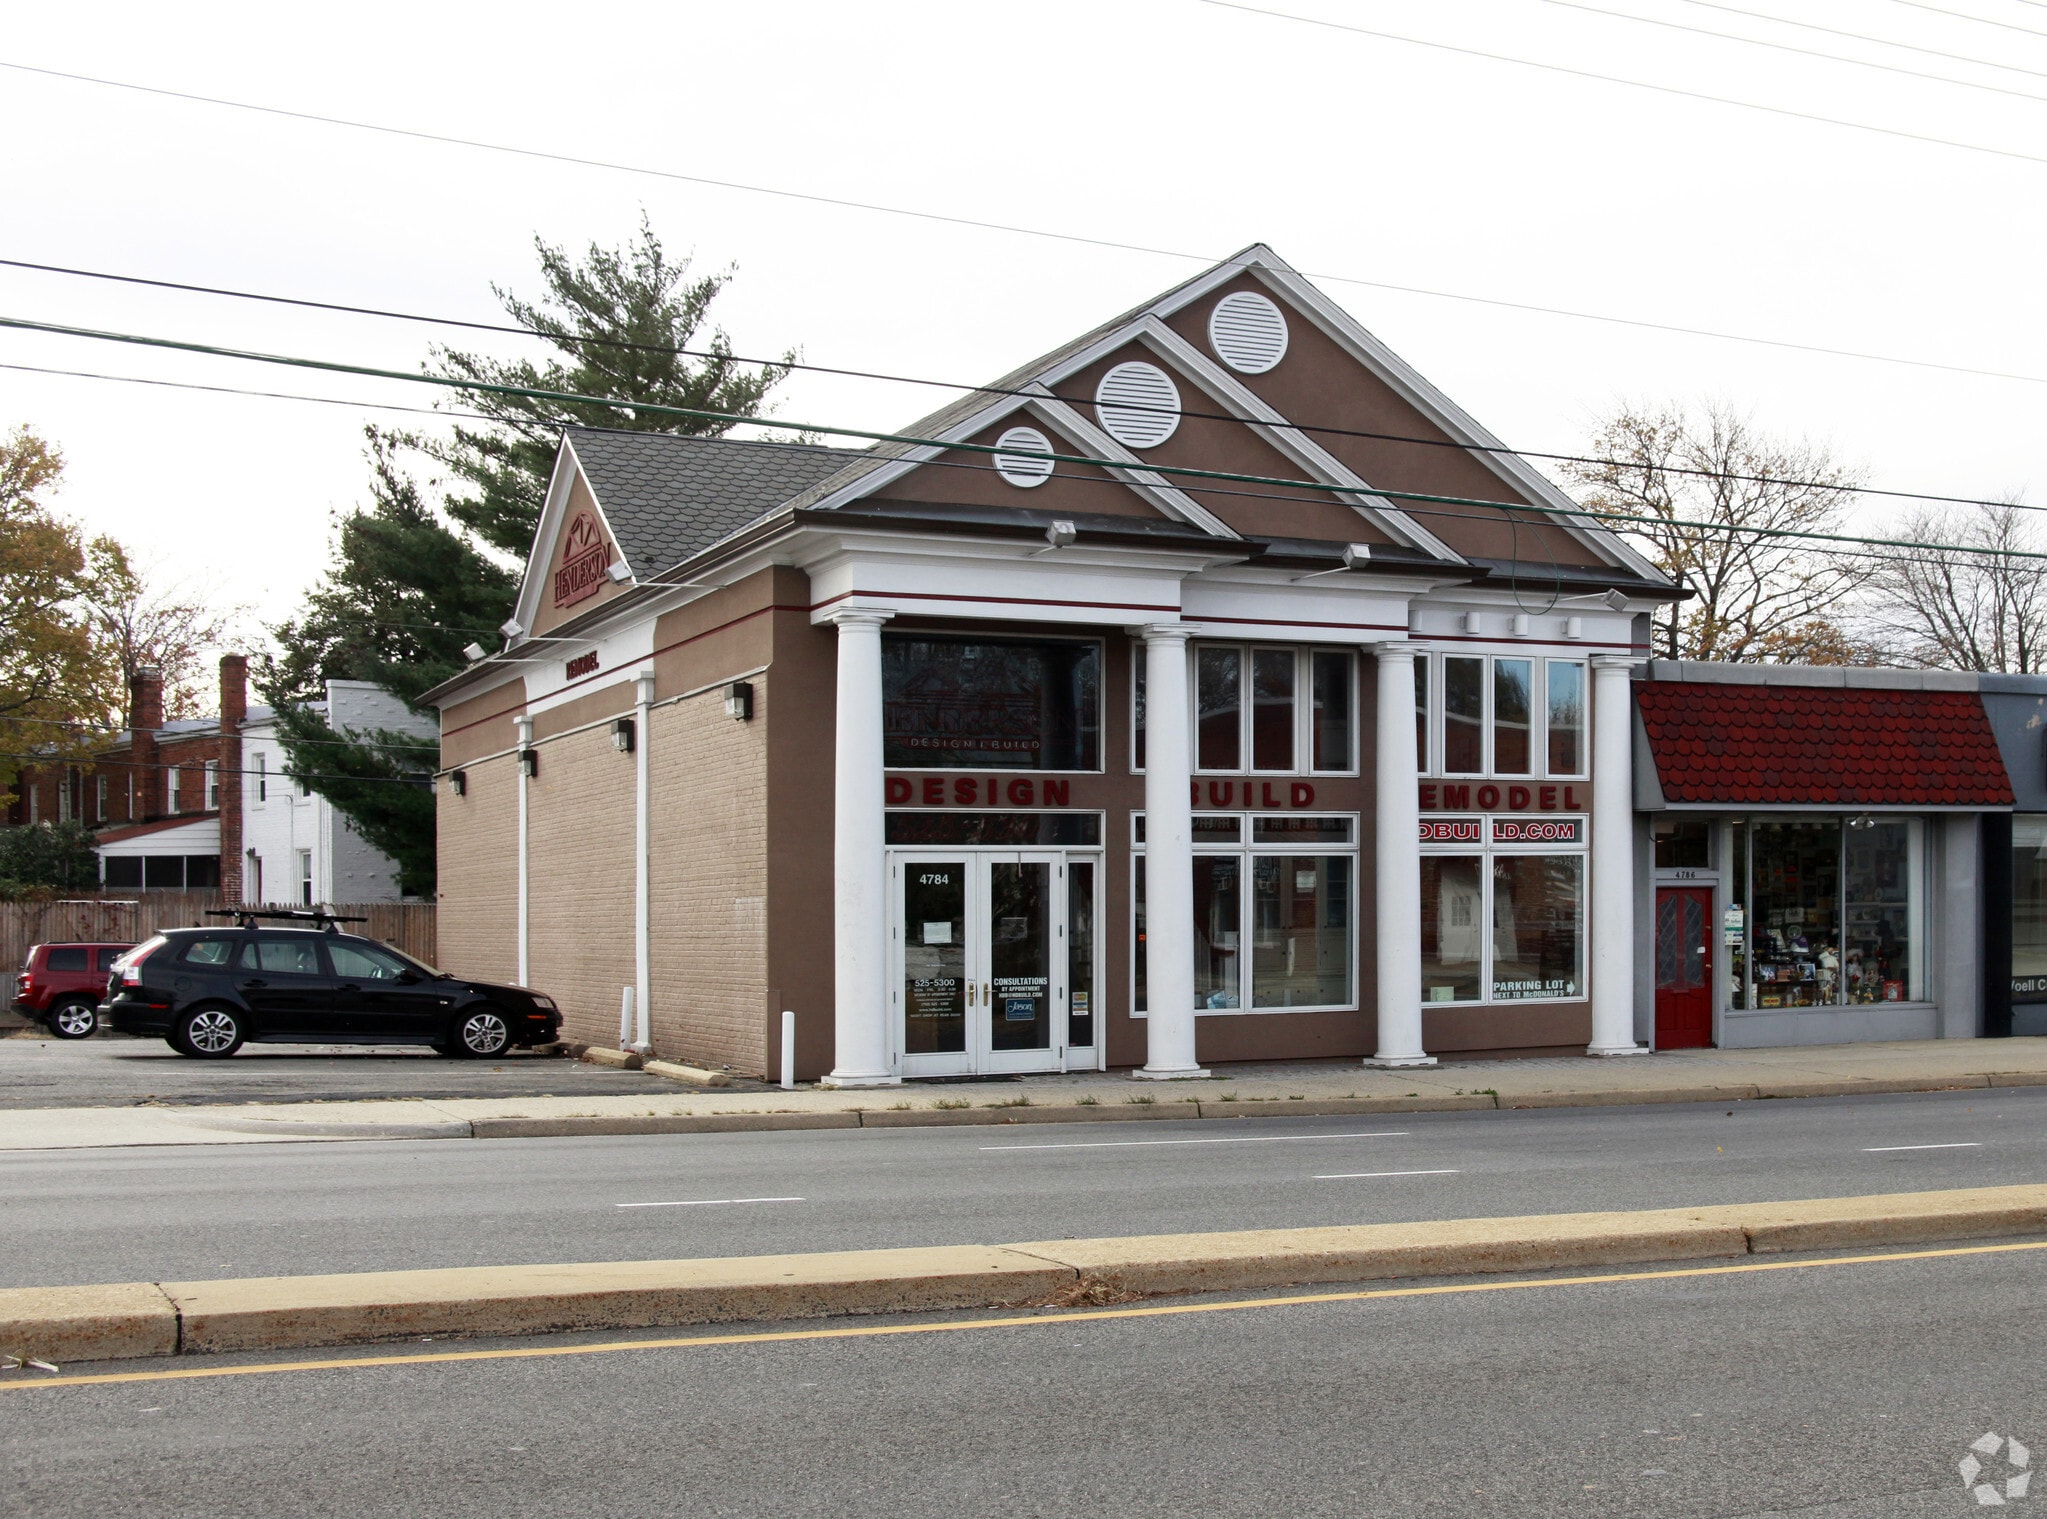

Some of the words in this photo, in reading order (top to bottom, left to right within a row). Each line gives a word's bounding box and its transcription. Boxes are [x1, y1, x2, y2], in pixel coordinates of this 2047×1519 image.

[910, 737, 973, 748] DESIGN
[990, 738, 1040, 749] BUILD
[885, 777, 1070, 806] DESIGN
[919, 873, 949, 885] 4784
[1675, 871, 1696, 879] 4786
[914, 978, 956, 987] 525-5300
[993, 977, 1048, 986] CONSULTATIONS
[1493, 981, 1542, 991] PARKING
[1545, 980, 1564, 989] LOT
[1493, 991, 1510, 999] NEXT
[1523, 989, 1564, 998] McDONALD'S
[1006, 1001, 1034, 1014] Jason
